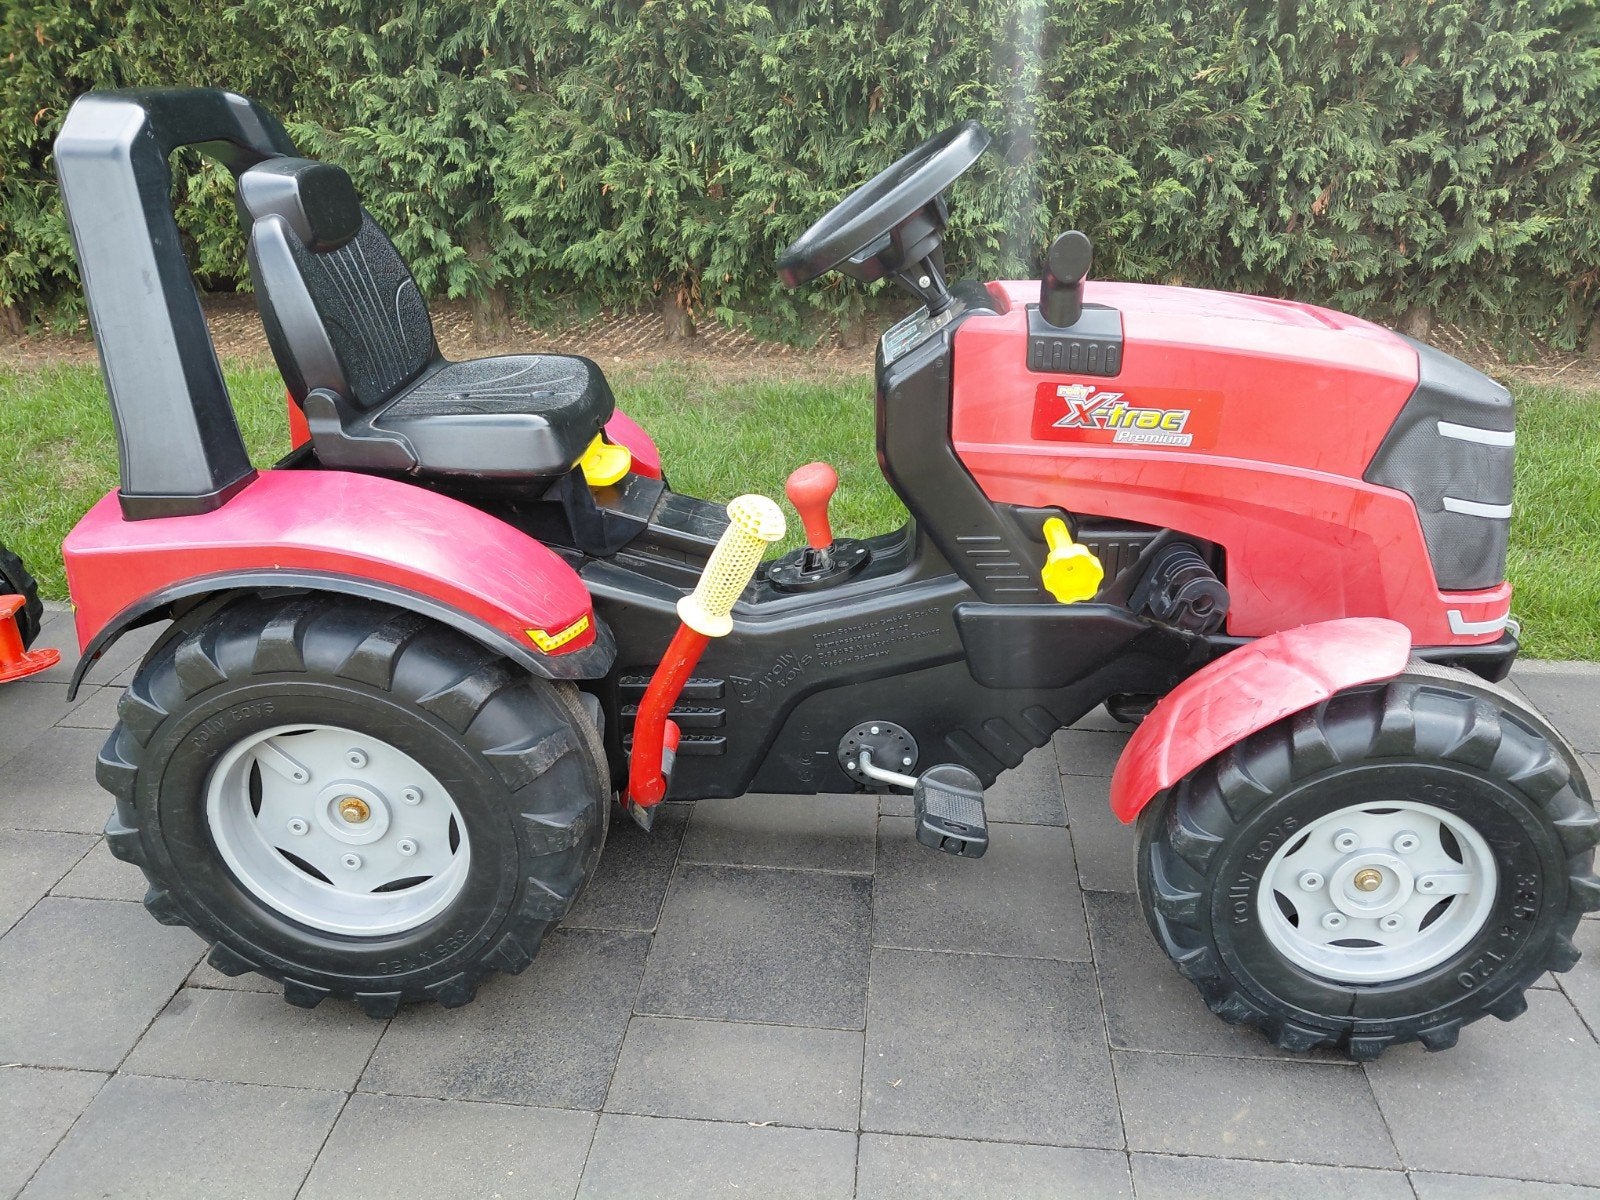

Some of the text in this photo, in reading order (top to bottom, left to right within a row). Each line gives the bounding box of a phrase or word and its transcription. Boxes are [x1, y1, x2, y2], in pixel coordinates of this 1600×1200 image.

[1055, 392, 1190, 430] X-trac
[1117, 431, 1193, 446] Premium
[1228, 871, 1258, 924] rolly
